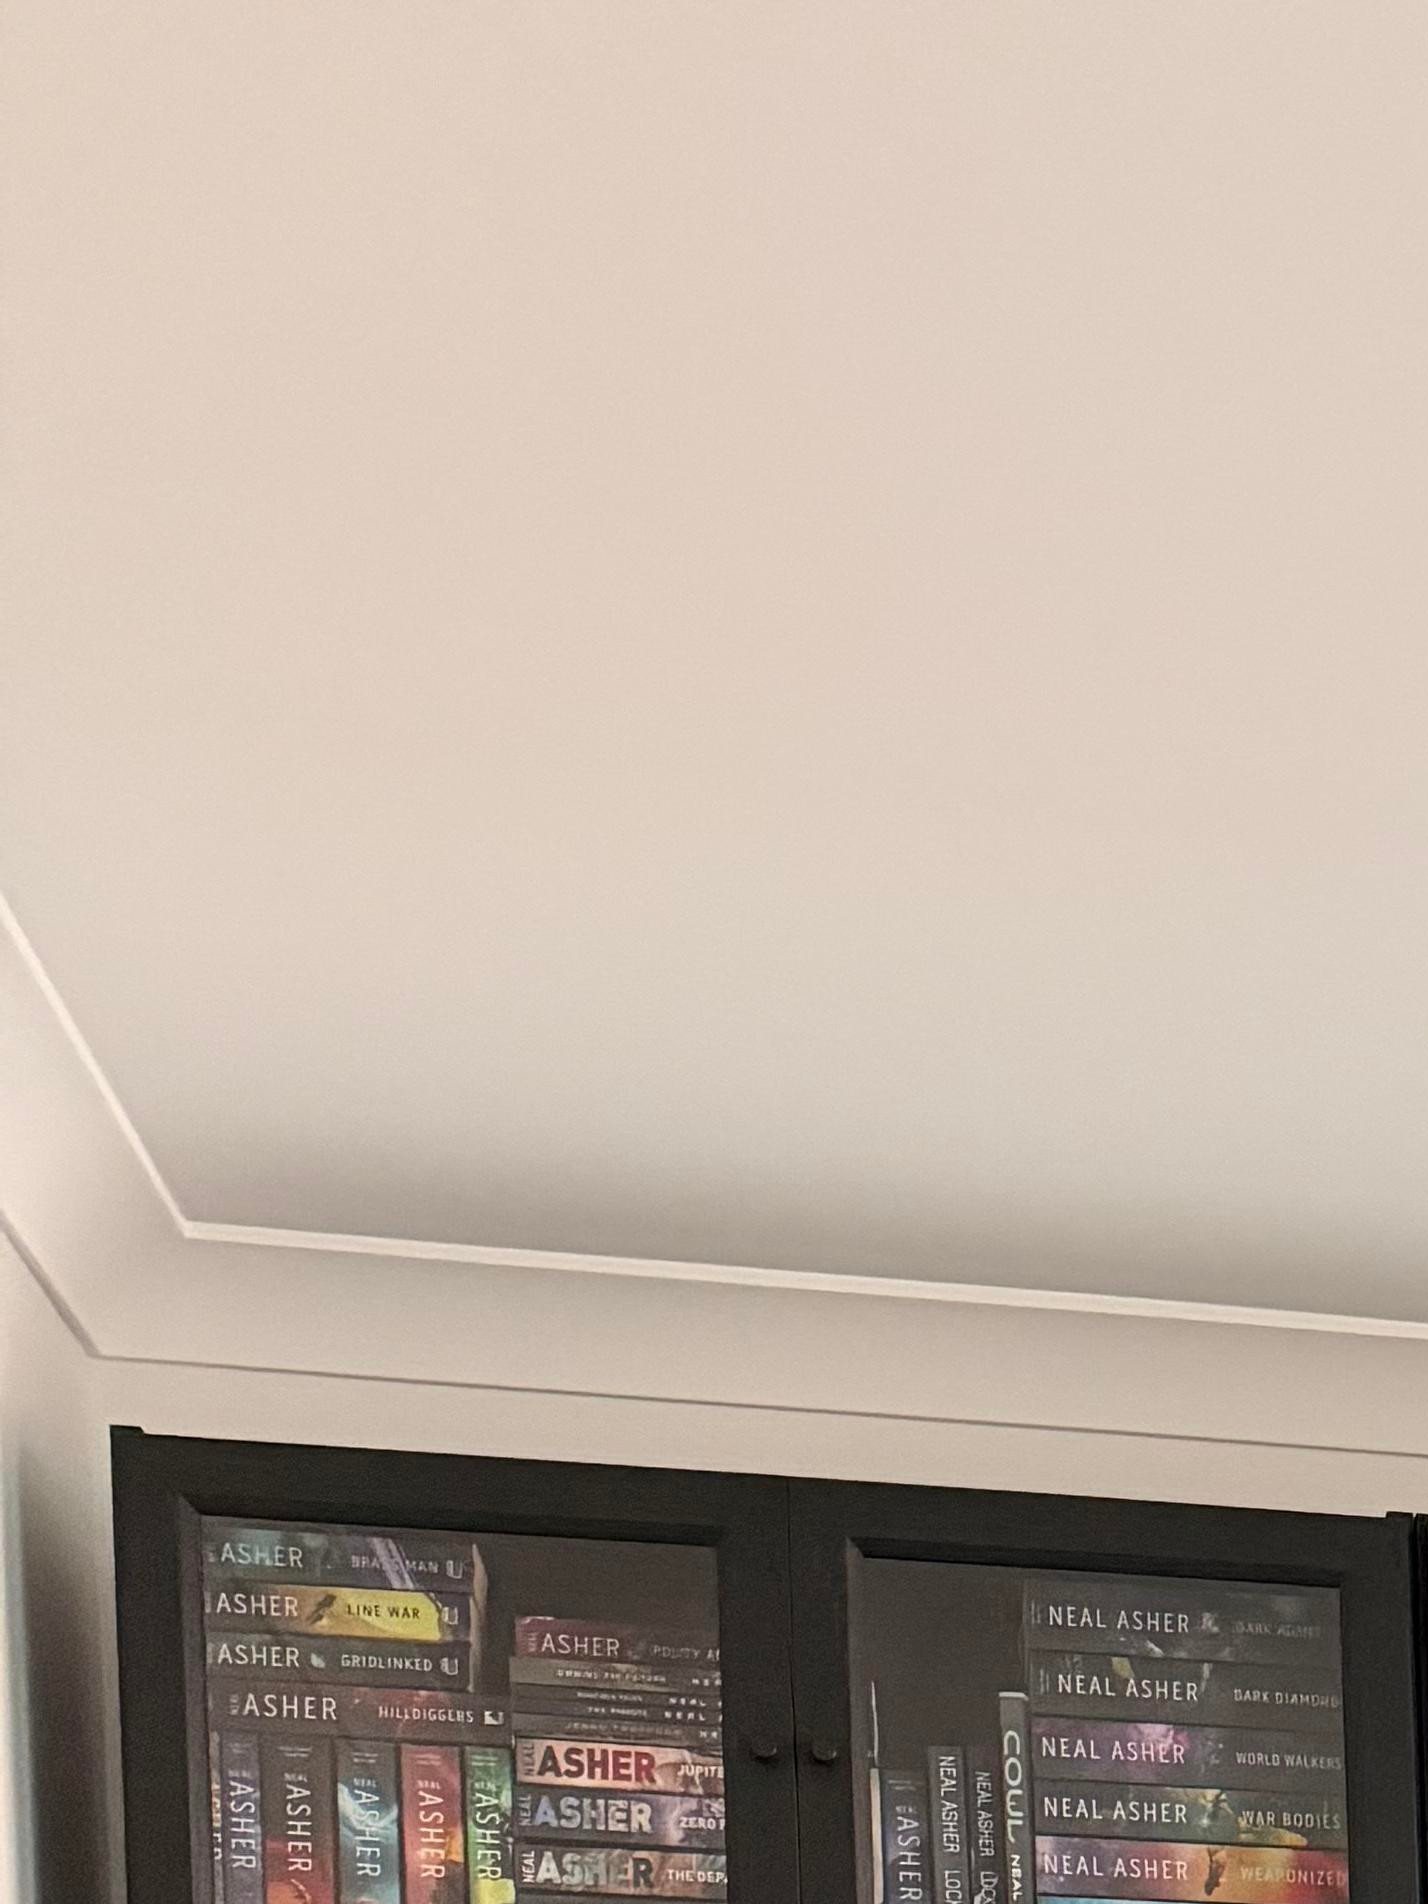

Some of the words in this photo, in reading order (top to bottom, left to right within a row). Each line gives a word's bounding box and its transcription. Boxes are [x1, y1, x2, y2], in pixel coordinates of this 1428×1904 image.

[221, 1543, 303, 1568] ASHER
[217, 1593, 298, 1617] ASHER
[347, 1603, 381, 1619] LINE
[387, 1605, 420, 1620] WAR
[1048, 1606, 1107, 1629] NEAL
[218, 1644, 300, 1668] ASHER
[341, 1655, 433, 1673] GRIDLINKED
[542, 1633, 620, 1657] ASHER
[1058, 1675, 1116, 1696] NEAL
[244, 1693, 338, 1720] ASHER
[1042, 1738, 1100, 1761] NEAL
[538, 1747, 656, 1783] ASHER
[1004, 1731, 1027, 1843] COWL
[229, 1781, 256, 1870] ASHER
[287, 1784, 312, 1873] ASHER
[536, 1801, 652, 1833] ASHER
[1243, 1811, 1276, 1825] WAR
[1282, 1813, 1341, 1828] BODIES
[353, 1789, 381, 1879] ASHER
[418, 1790, 444, 1881] ASHER
[522, 1850, 535, 1883] NEAL
[537, 1853, 653, 1888] ASHER
